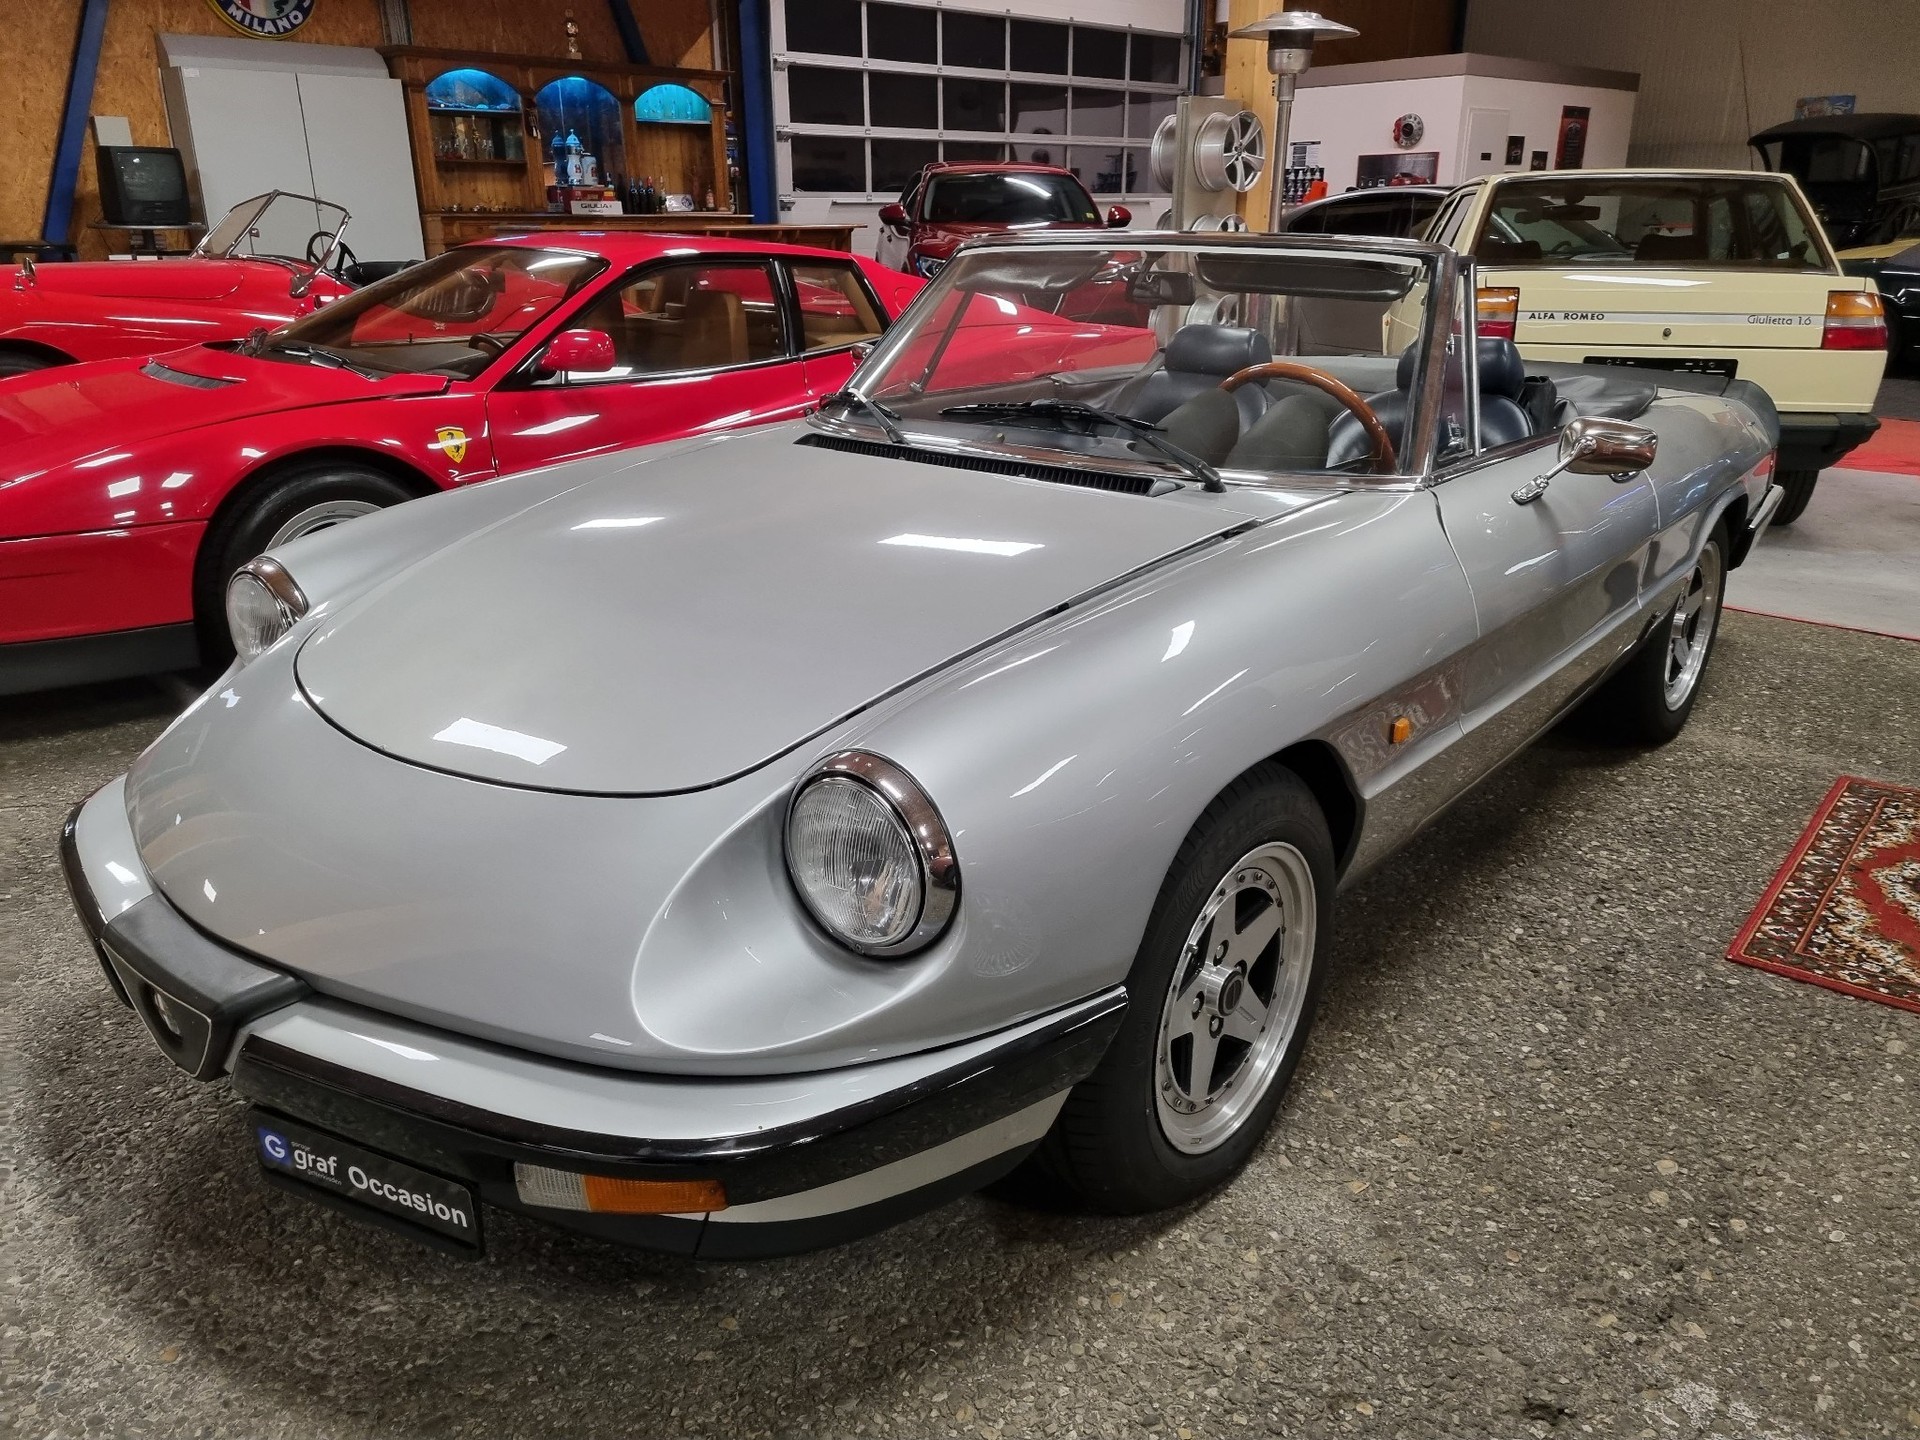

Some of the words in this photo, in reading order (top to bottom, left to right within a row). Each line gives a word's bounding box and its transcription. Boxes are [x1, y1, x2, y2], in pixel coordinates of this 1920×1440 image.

[227, 3, 304, 34] MILANO
[1528, 312, 1555, 320] ALFA
[1563, 312, 1605, 321] ROMEO
[1747, 314, 1793, 325] Giulietta
[1798, 316, 1812, 326] 1.6
[264, 1134, 286, 1159] G
[294, 1149, 337, 1176] graf
[348, 1165, 468, 1228] Occasion
